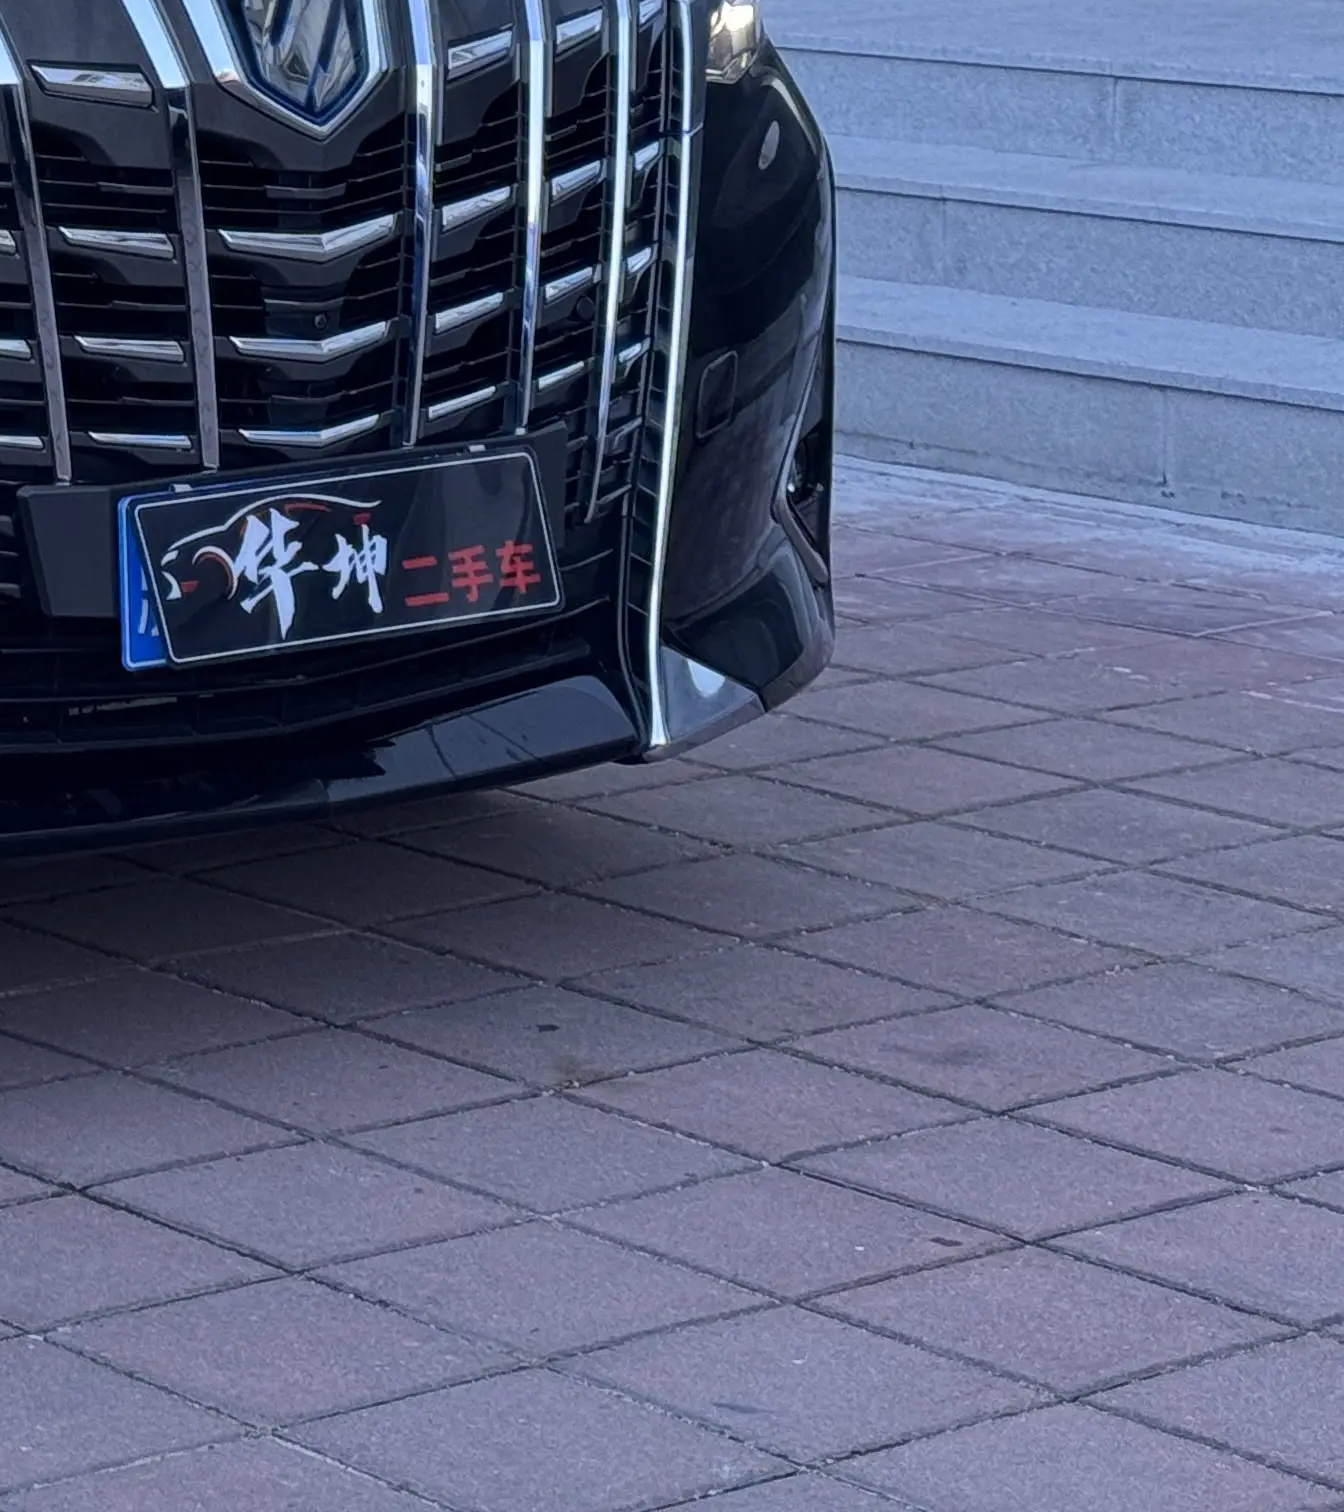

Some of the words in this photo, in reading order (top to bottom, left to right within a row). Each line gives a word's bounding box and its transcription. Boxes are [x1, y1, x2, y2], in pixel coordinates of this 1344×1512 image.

[233, 508, 388, 640] 华坤
[402, 540, 542, 607] 二手车
